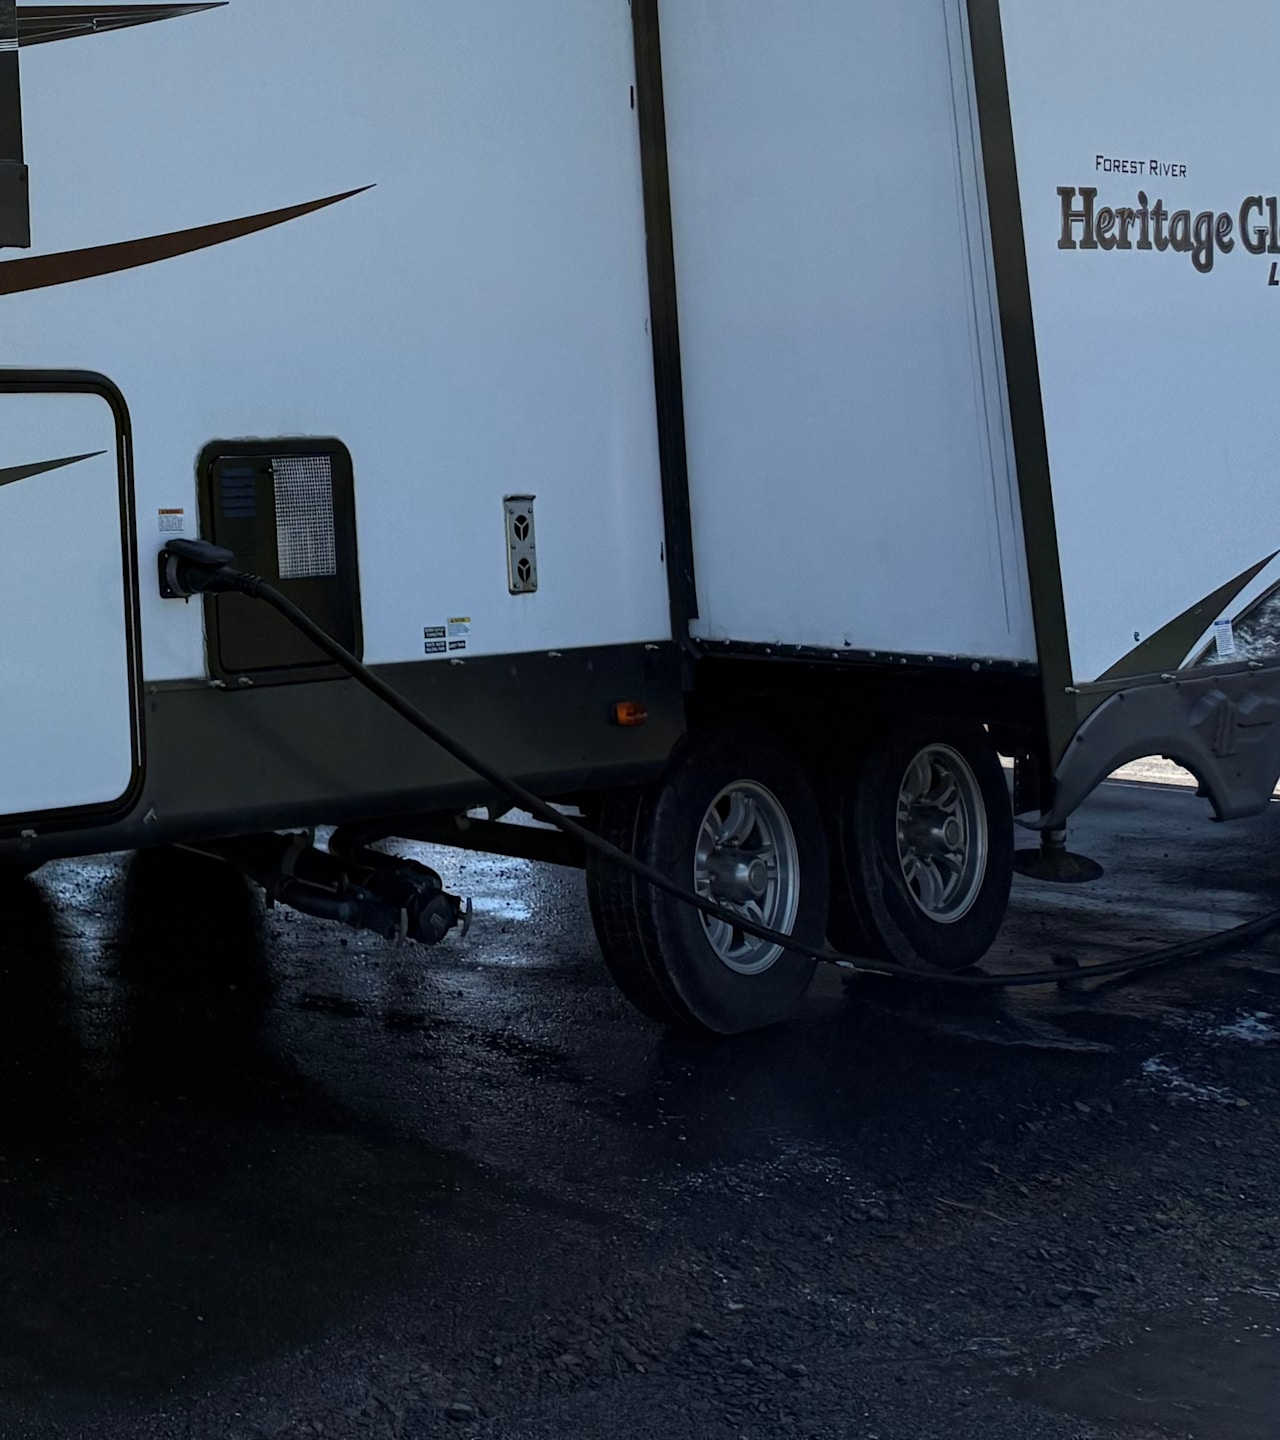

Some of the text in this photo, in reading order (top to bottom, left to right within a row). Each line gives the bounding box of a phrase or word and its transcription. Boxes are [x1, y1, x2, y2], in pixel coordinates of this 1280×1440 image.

[1095, 154, 1187, 178] FOREST RIVER
[1056, 186, 1236, 274] Heritage
